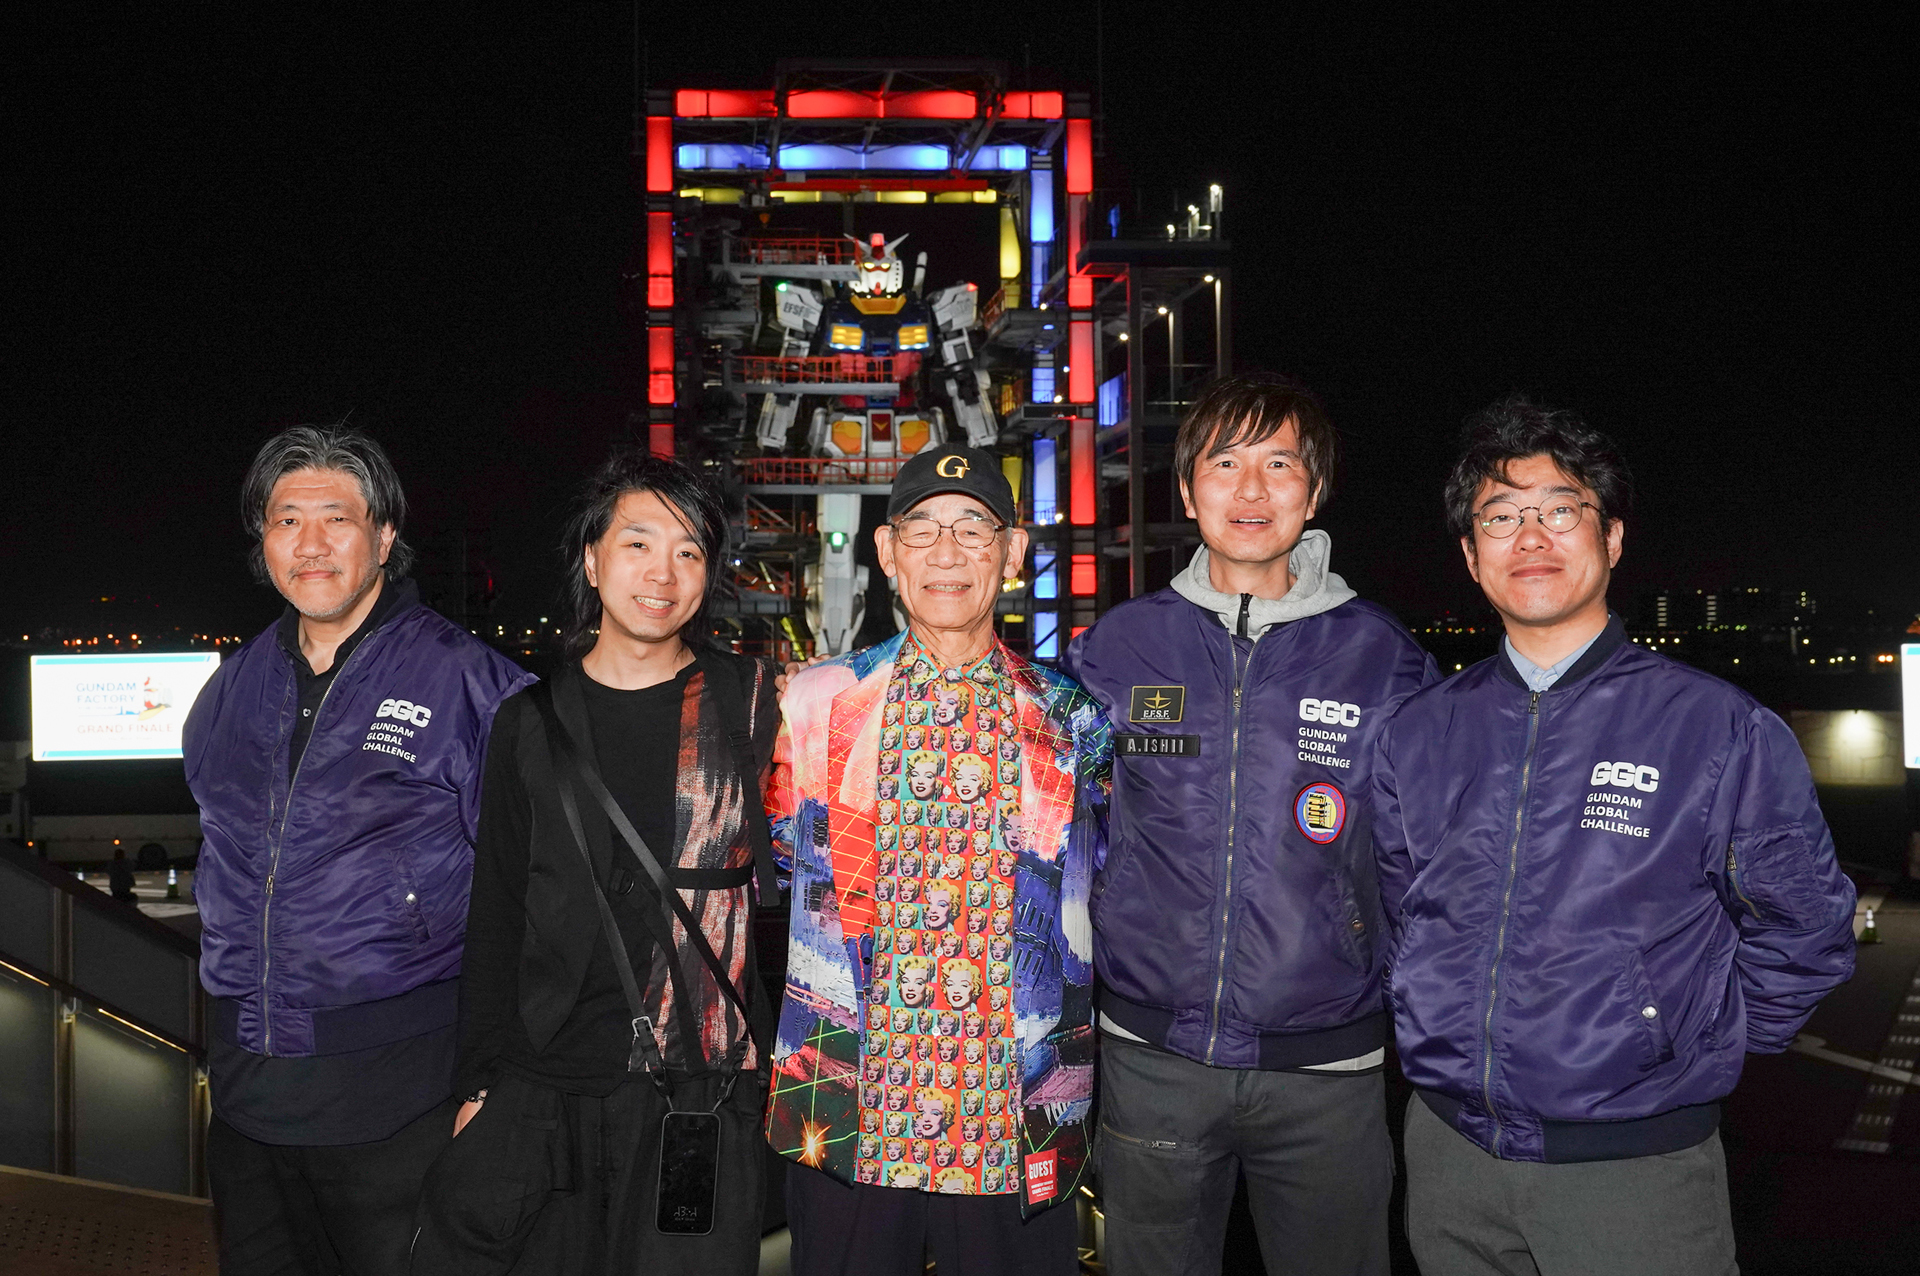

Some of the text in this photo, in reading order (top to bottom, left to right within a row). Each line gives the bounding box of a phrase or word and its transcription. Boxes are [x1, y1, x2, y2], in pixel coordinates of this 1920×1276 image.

[936, 455, 970, 478] G
[76, 682, 137, 692] GUNDAM
[77, 694, 135, 703] FACTORY
[376, 698, 432, 728] GGC
[1299, 698, 1361, 728] GGC
[77, 723, 174, 734] GRAND FINALE
[370, 722, 415, 738] GUNDAM
[1298, 727, 1347, 743] GUNDAM
[366, 733, 402, 746] GLOBAL
[1127, 738, 1184, 753] A.ISHII
[1298, 739, 1337, 754] GLOBAL
[362, 742, 417, 763] CHALLENGE
[1297, 751, 1351, 769] CHALLENGE
[1590, 761, 1660, 793] GGC
[1586, 792, 1642, 809] GUNDAM
[1583, 805, 1629, 820] GLOBAL
[1580, 818, 1650, 838] CHALLENGE
[1028, 1159, 1053, 1180] GUEST
